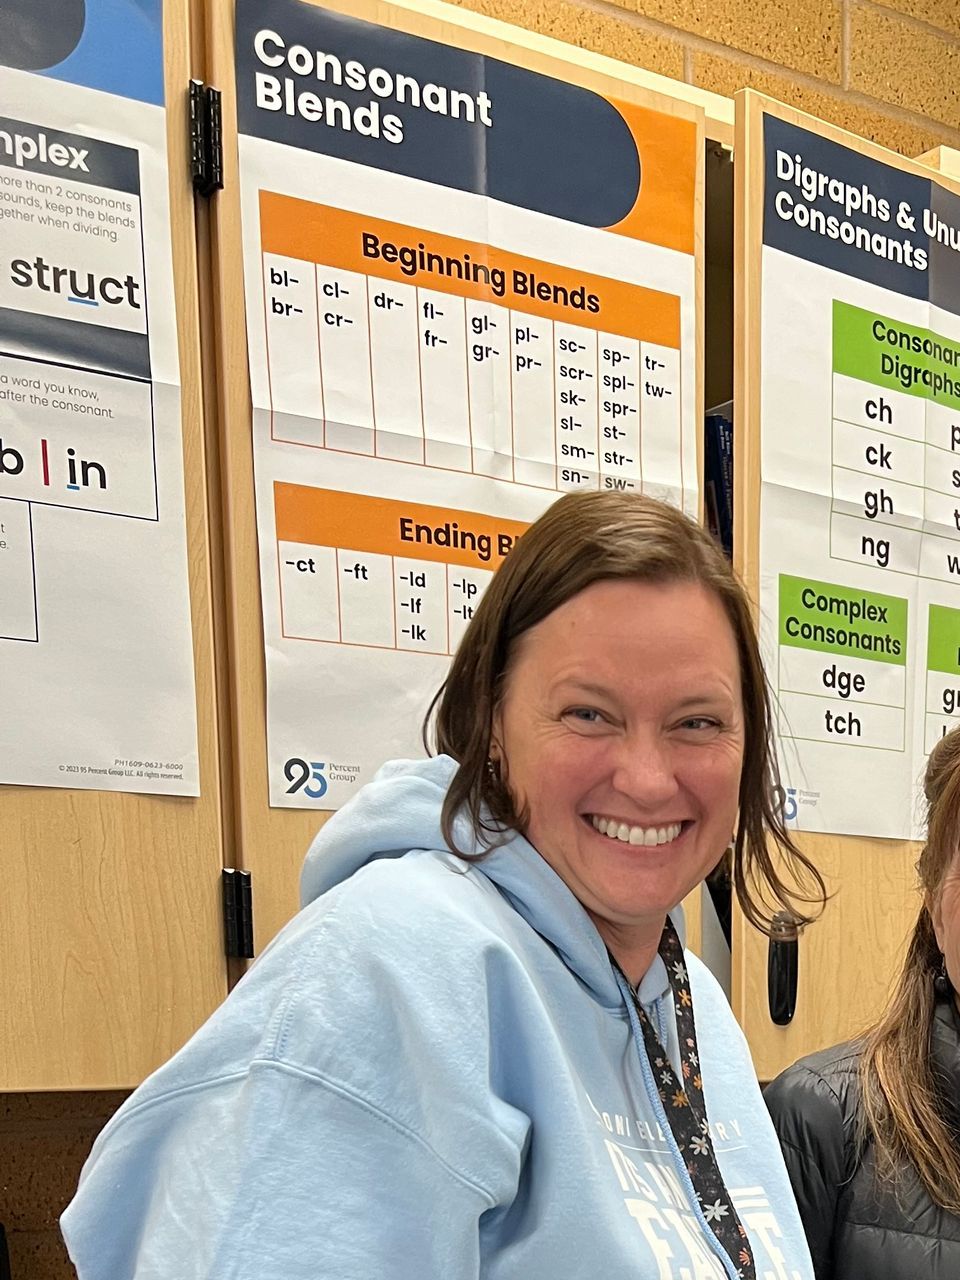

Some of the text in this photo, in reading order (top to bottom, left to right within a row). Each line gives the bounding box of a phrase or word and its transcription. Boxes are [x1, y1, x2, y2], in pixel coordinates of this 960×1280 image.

[254, 29, 492, 127] Consonant
[255, 73, 405, 145] Blends
[26, 180, 53, 194] than
[56, 186, 63, 198] 2
[66, 191, 132, 213] consonants
[776, 149, 891, 223] Digraphs
[896, 202, 916, 231] &
[38, 215, 70, 231] when
[46, 199, 74, 217] keep
[77, 207, 95, 220] the
[99, 211, 136, 229] blends
[775, 191, 929, 271] Consonants
[270, 268, 299, 288] bl-
[362, 232, 601, 313] Beginning Blends
[10, 256, 141, 309] struct
[323, 280, 350, 299] cl-
[271, 298, 303, 317] br-
[374, 291, 404, 310] dr-
[324, 311, 353, 328] cr-
[423, 302, 444, 320] fl-
[471, 314, 497, 334] gl-
[424, 330, 448, 348] fr-
[515, 326, 540, 345] pl-
[473, 343, 500, 362] gr-
[559, 338, 586, 354] sc-
[516, 354, 542, 373] pr-
[603, 346, 631, 366] sp-
[645, 355, 666, 372] tr-
[560, 365, 594, 381] scr-
[12, 375, 41, 390] word
[44, 382, 65, 399] you
[68, 385, 99, 402] know,
[603, 373, 635, 393] spl-
[645, 382, 672, 398] tw-
[30, 393, 49, 407] the
[560, 389, 586, 406] sk-
[603, 399, 637, 419] spr-
[865, 397, 893, 424] ch
[561, 415, 582, 431] sl-
[604, 424, 626, 440] st-
[561, 444, 595, 460] sm-
[604, 450, 633, 466] str-
[865, 444, 892, 470] ck
[67, 448, 107, 490] in
[562, 469, 590, 485] sn-
[864, 489, 894, 519] gh
[399, 516, 491, 561] Ending
[861, 536, 890, 567] ng
[286, 557, 316, 575] -ct
[344, 564, 369, 580] -ft
[400, 571, 427, 588] -ld
[453, 578, 478, 599] -lp
[401, 598, 422, 614] -lf
[801, 588, 888, 624] Complex
[402, 624, 427, 641] -lk
[785, 617, 902, 656] Consonants
[822, 665, 866, 698] dge
[825, 709, 862, 737] tch
[329, 762, 361, 773] Percent
[283, 757, 328, 798] 95
[329, 772, 356, 784] Group
